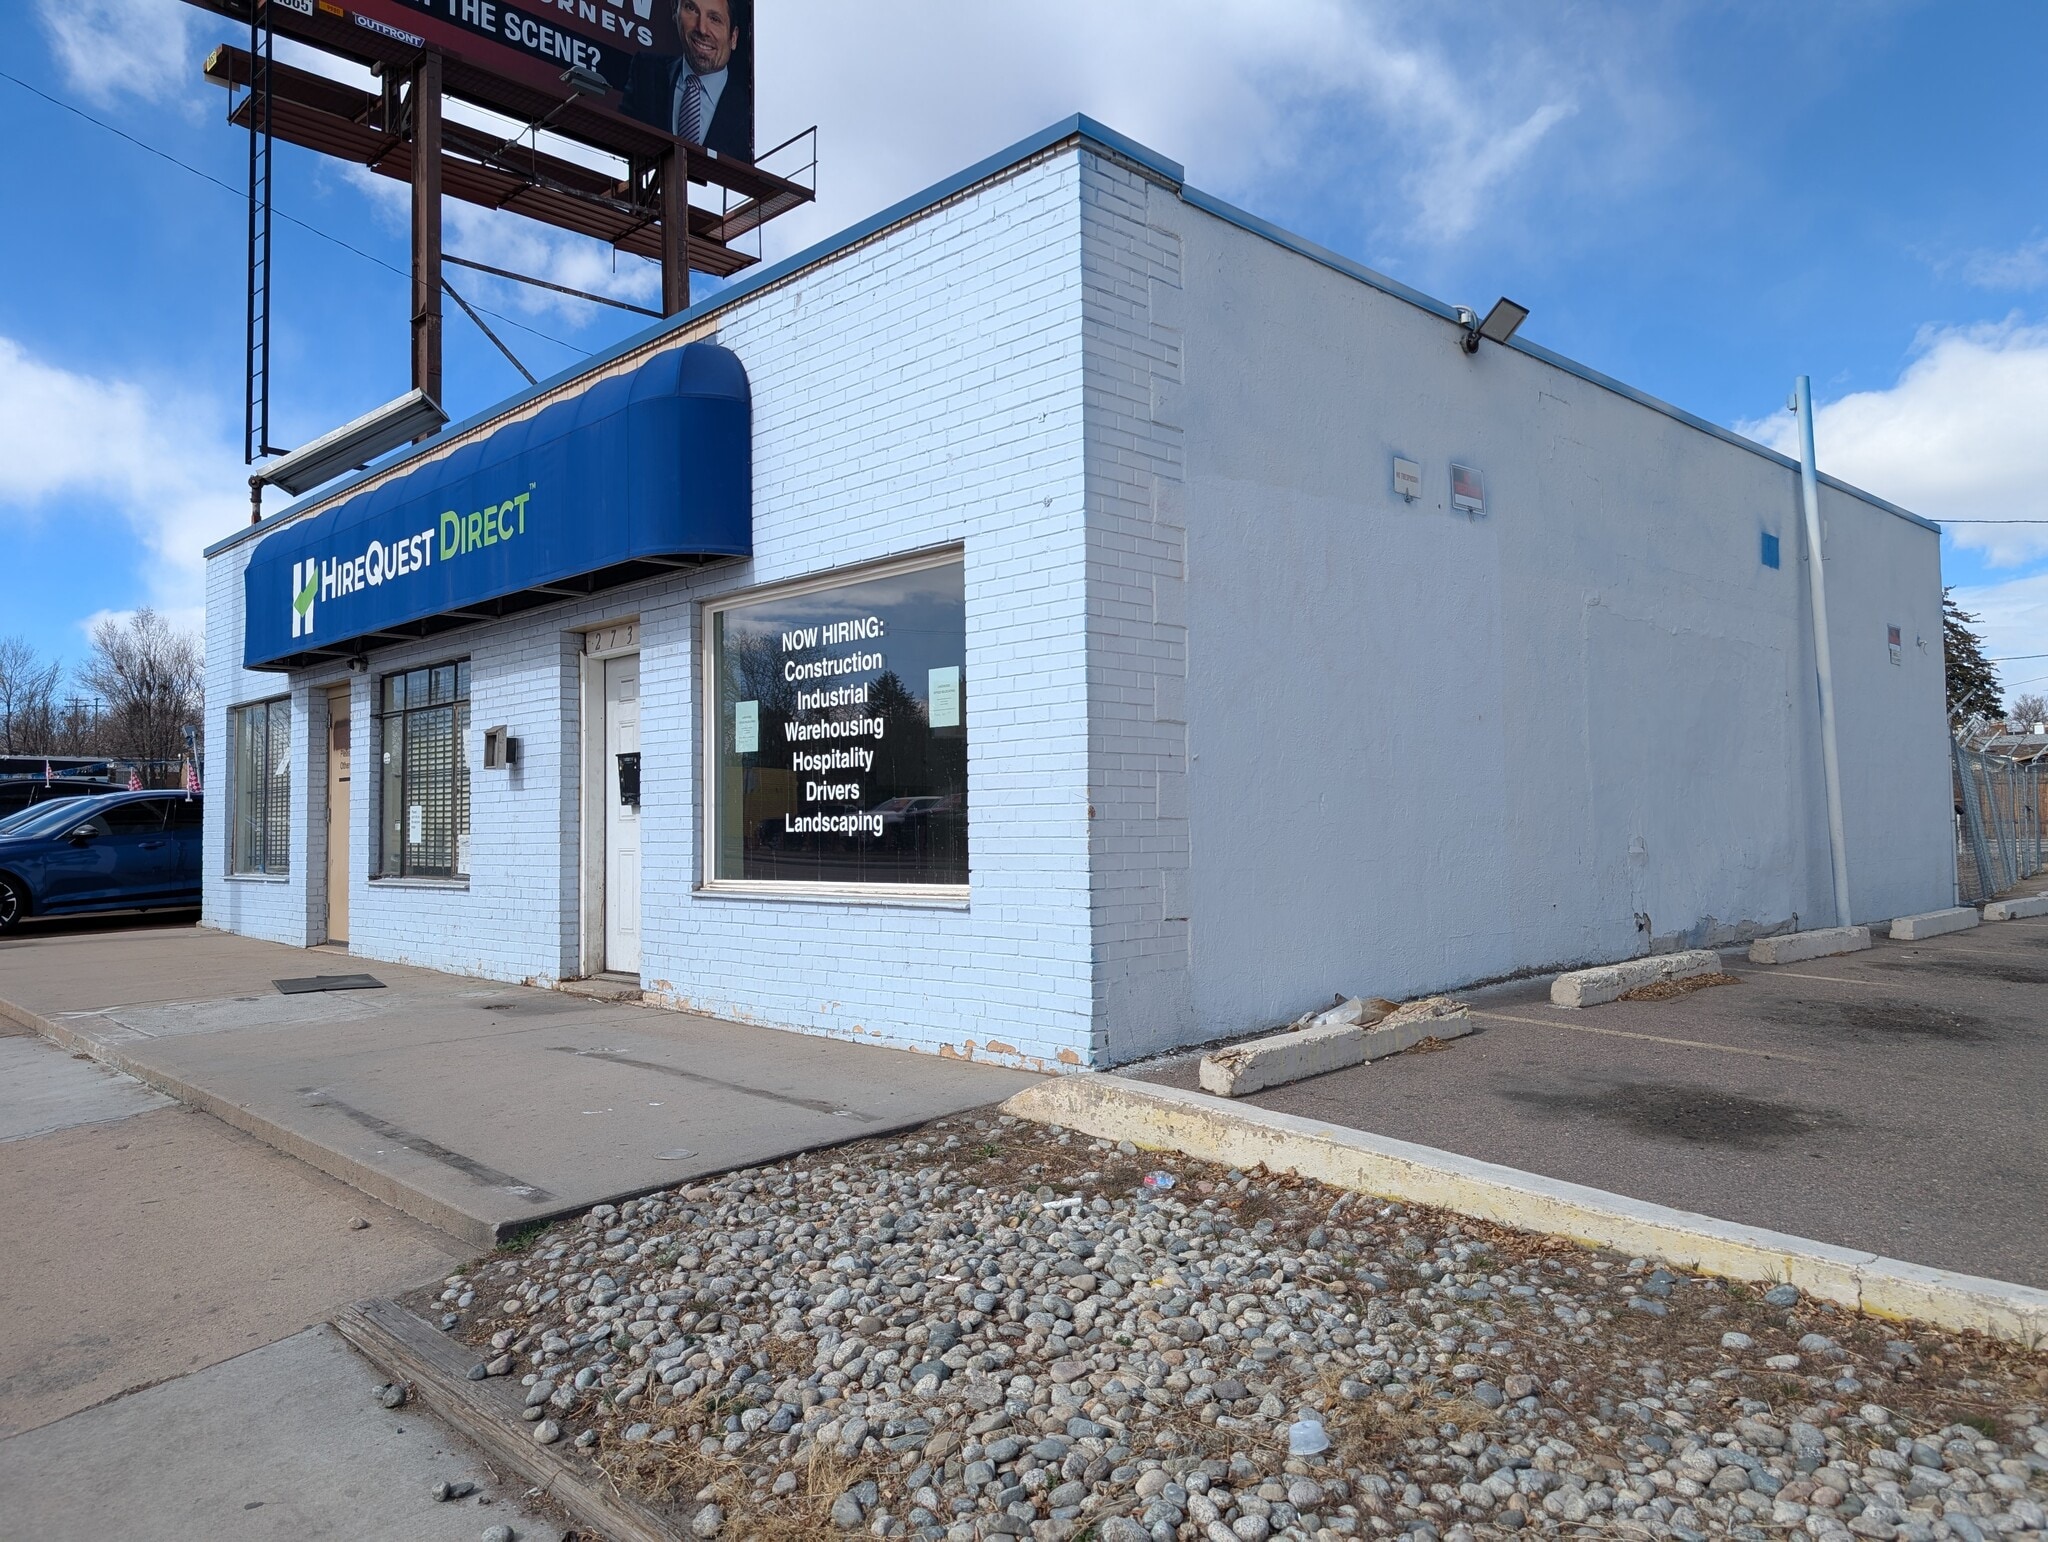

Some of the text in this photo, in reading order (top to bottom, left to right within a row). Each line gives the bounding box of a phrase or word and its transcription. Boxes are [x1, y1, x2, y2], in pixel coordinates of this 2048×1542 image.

[357, 16, 421, 46] OUTFRONT
[541, 0, 653, 47] RNEYS
[504, 12, 601, 73] SCENE?
[782, 616, 884, 652] NOW HIRING:
[784, 652, 883, 682] Construction
[797, 682, 868, 711] Industrial
[784, 715, 884, 742] Warehousing
[793, 747, 874, 775] Hospitality
[806, 781, 860, 802] Drivers
[785, 811, 884, 837] Landscaping
